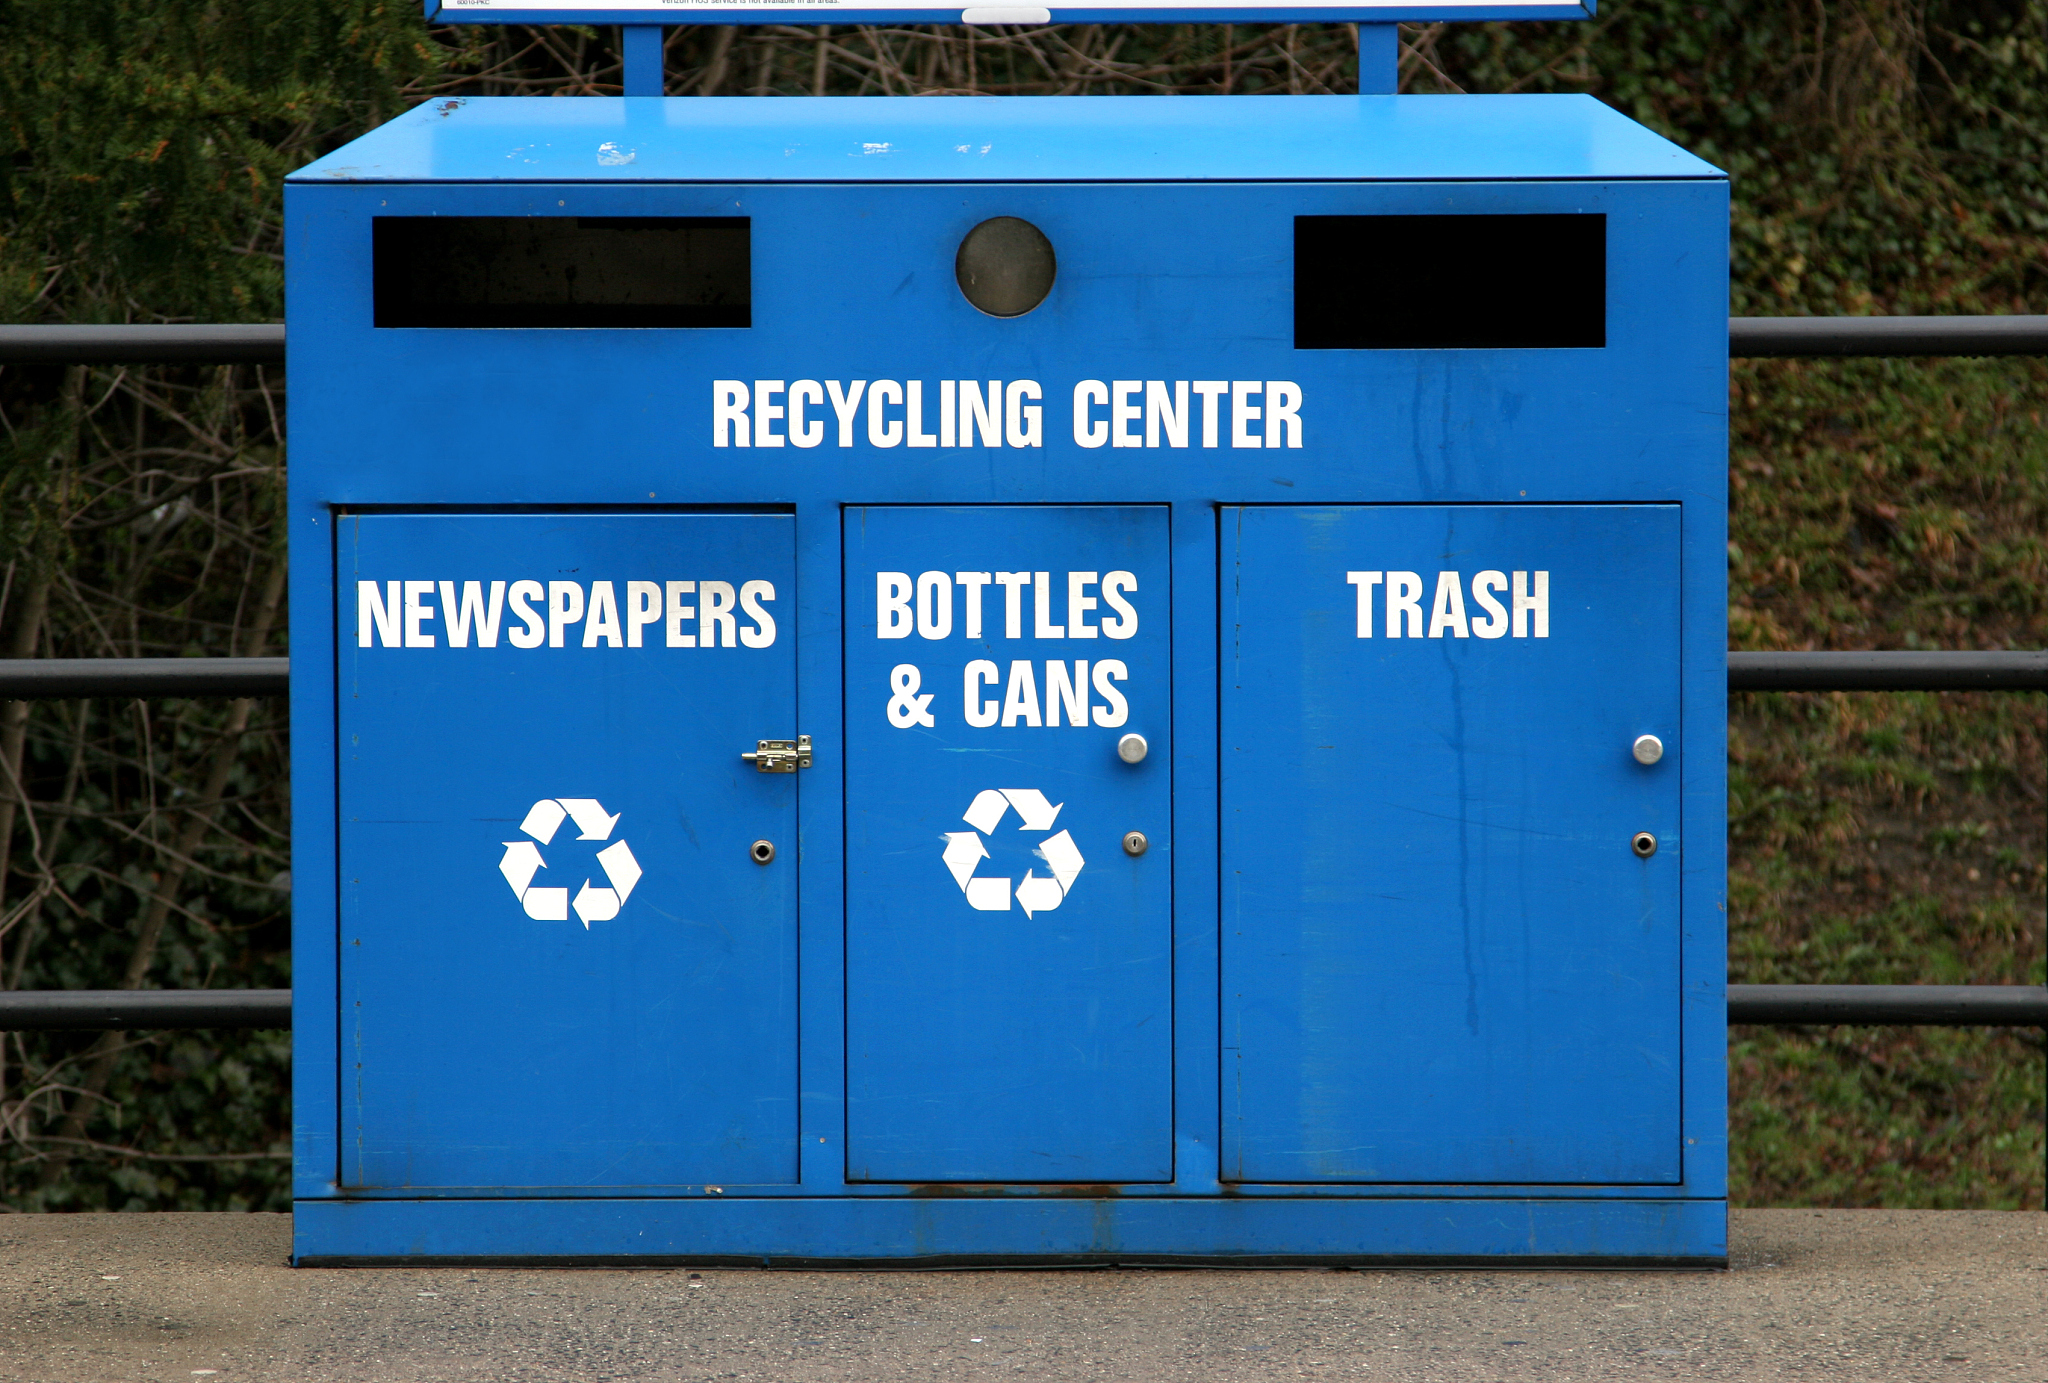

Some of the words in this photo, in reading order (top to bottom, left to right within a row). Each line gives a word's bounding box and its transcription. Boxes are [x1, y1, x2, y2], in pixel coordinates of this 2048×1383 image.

[713, 380, 1043, 449] RECYCLING
[1074, 380, 1303, 449] CENTER
[358, 580, 777, 649] NEWSPAPERS
[877, 571, 1138, 640] BOTTLES
[1346, 570, 1549, 639] TRASH
[886, 664, 935, 729] &
[964, 659, 1129, 728] CANS
